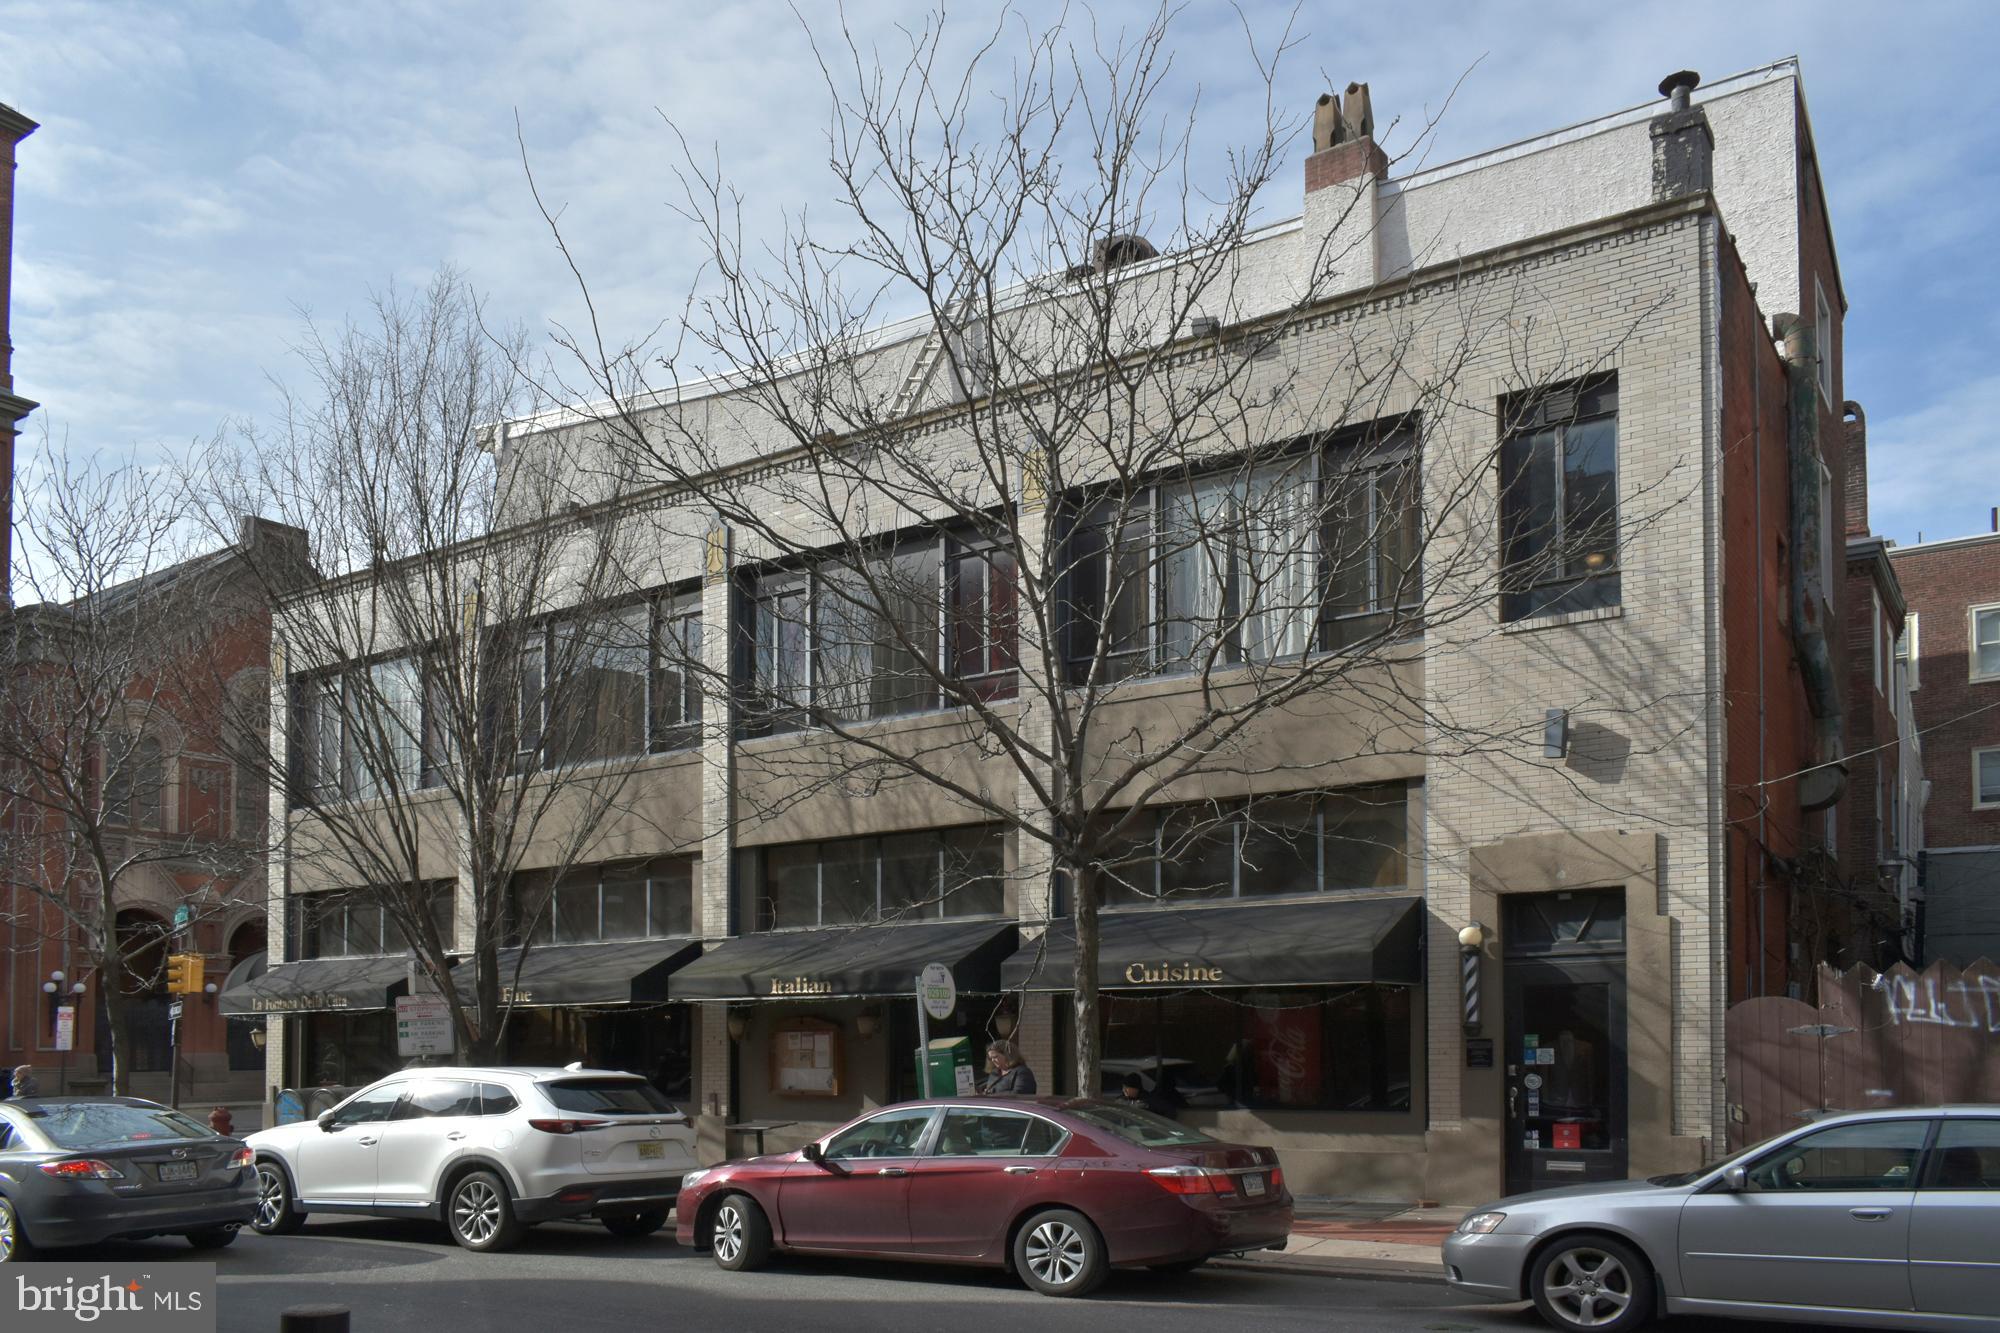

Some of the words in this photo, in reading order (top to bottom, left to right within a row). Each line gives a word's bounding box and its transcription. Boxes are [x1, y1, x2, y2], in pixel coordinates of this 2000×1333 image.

[1125, 961, 1223, 983] Cuisine
[770, 976, 832, 994] Italian
[502, 986, 532, 1002] Fne
[252, 998, 264, 1011] La
